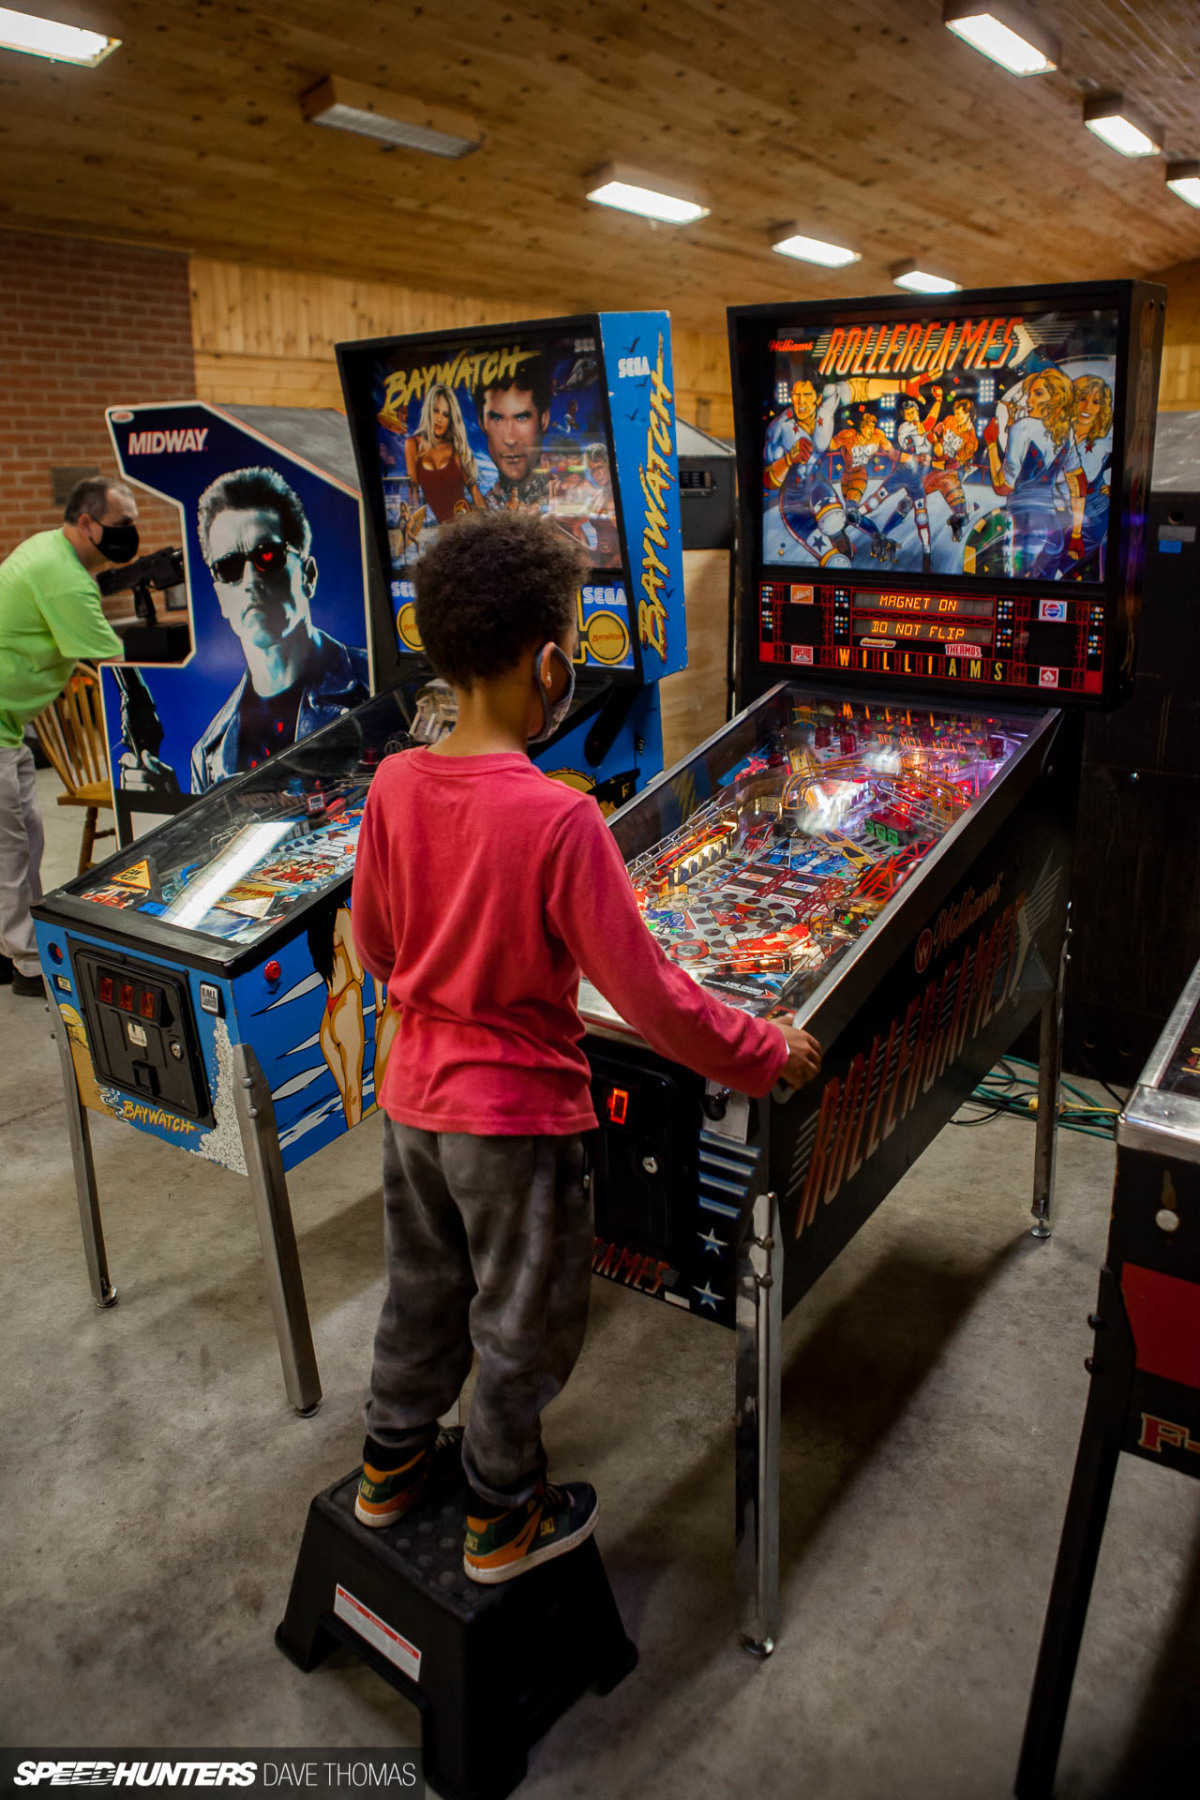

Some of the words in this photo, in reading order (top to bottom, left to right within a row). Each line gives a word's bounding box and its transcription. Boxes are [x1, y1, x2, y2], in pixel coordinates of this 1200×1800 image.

[767, 339, 814, 352] Williams
[817, 317, 1024, 376] ROLLERGAMES
[383, 345, 541, 413] BAYWATCH
[618, 355, 651, 378] SEGA
[128, 427, 209, 456] MIDWAY
[638, 330, 675, 665] BAYWATCH
[582, 586, 628, 606] SEGA
[879, 595, 931, 610] MAGNET
[938, 599, 958, 612] ON
[871, 620, 888, 634] DO
[895, 623, 922, 636] NOT
[929, 626, 965, 640] FLIP
[945, 644, 981, 657] THERMOS
[794, 890, 1027, 1241] ROLLERGAMES
[121, 1100, 202, 1135] BAYWATCH
